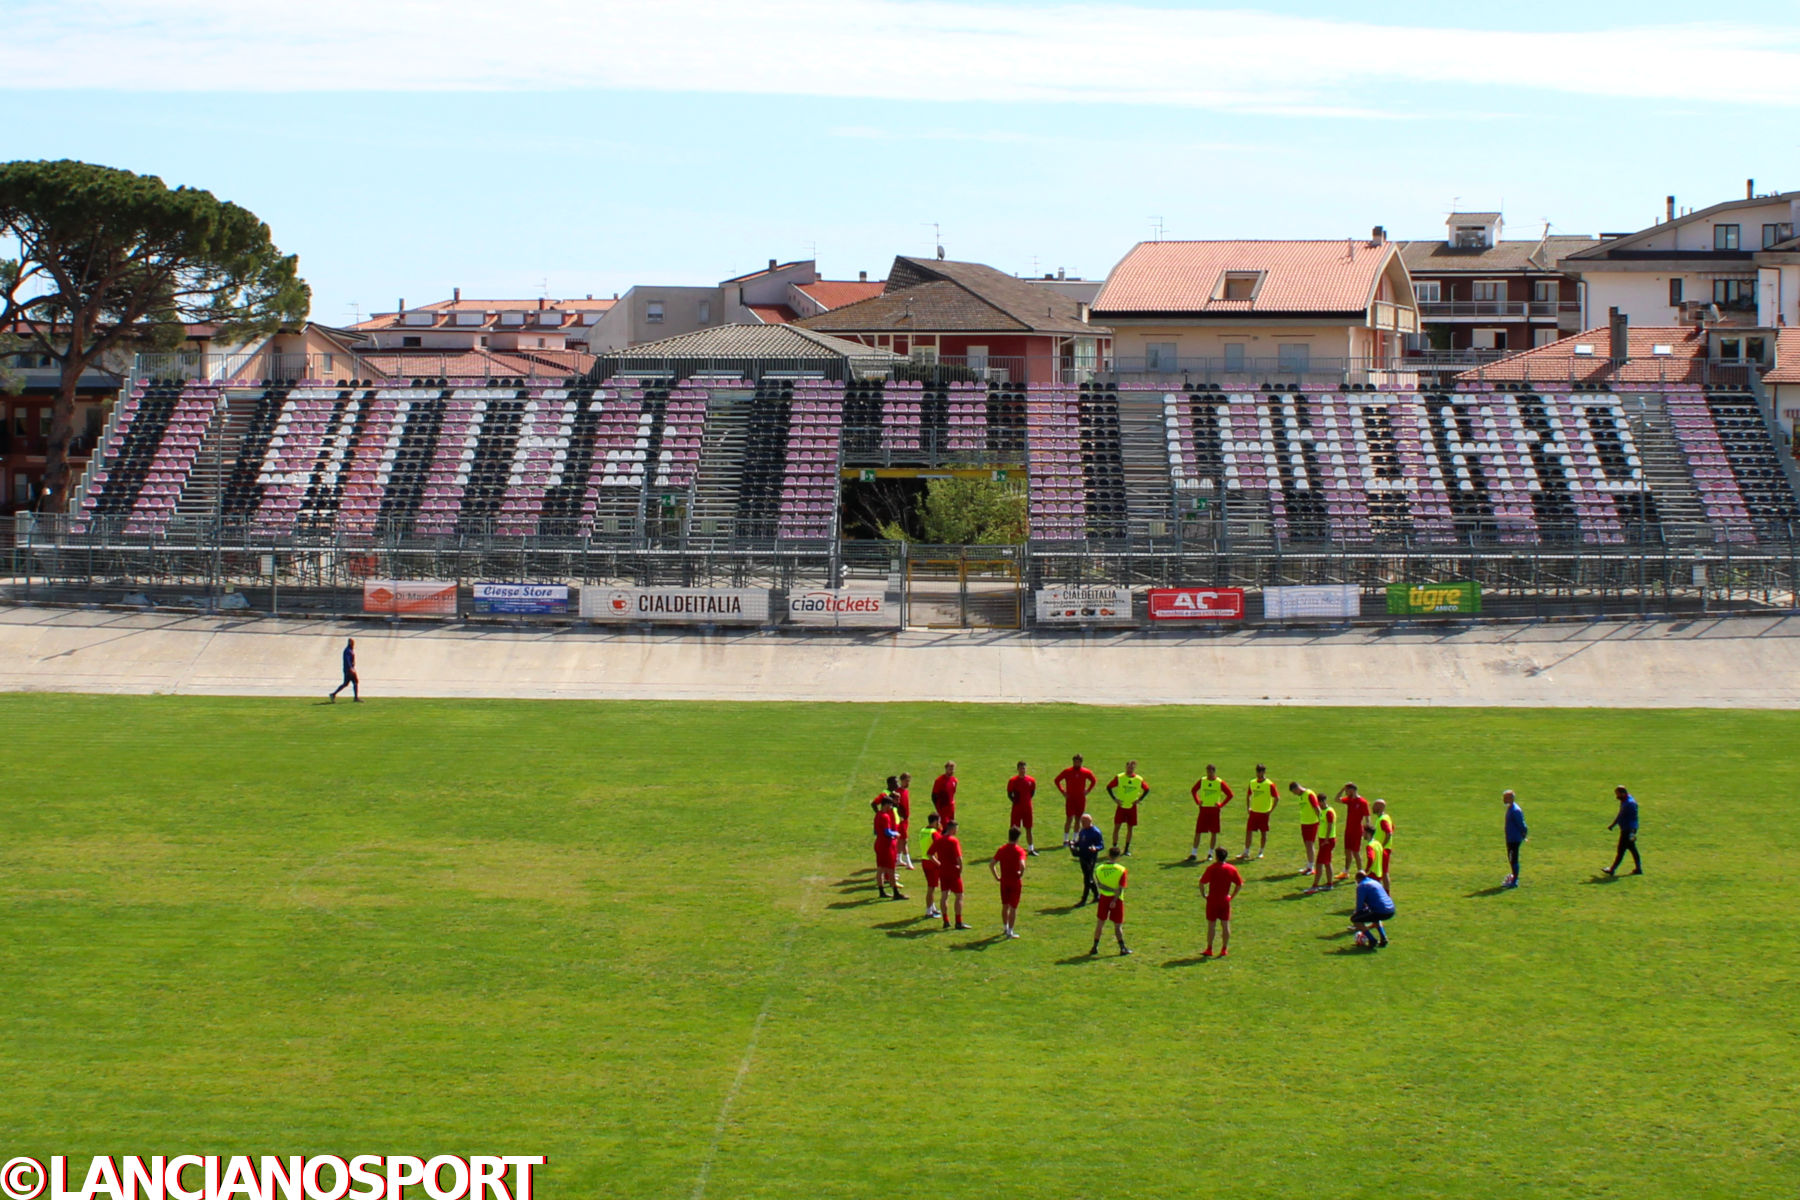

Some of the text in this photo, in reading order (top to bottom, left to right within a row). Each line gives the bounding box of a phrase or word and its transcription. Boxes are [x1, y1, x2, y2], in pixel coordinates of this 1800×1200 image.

[395, 593, 405, 601] Di
[407, 593, 439, 601] Marino
[523, 587, 553, 597] Store
[1063, 590, 1117, 600] CIALDEITALIA
[1409, 585, 1462, 611] tigre
[638, 594, 742, 614] CIALDEITALIA
[792, 594, 879, 612] ciaotickets
